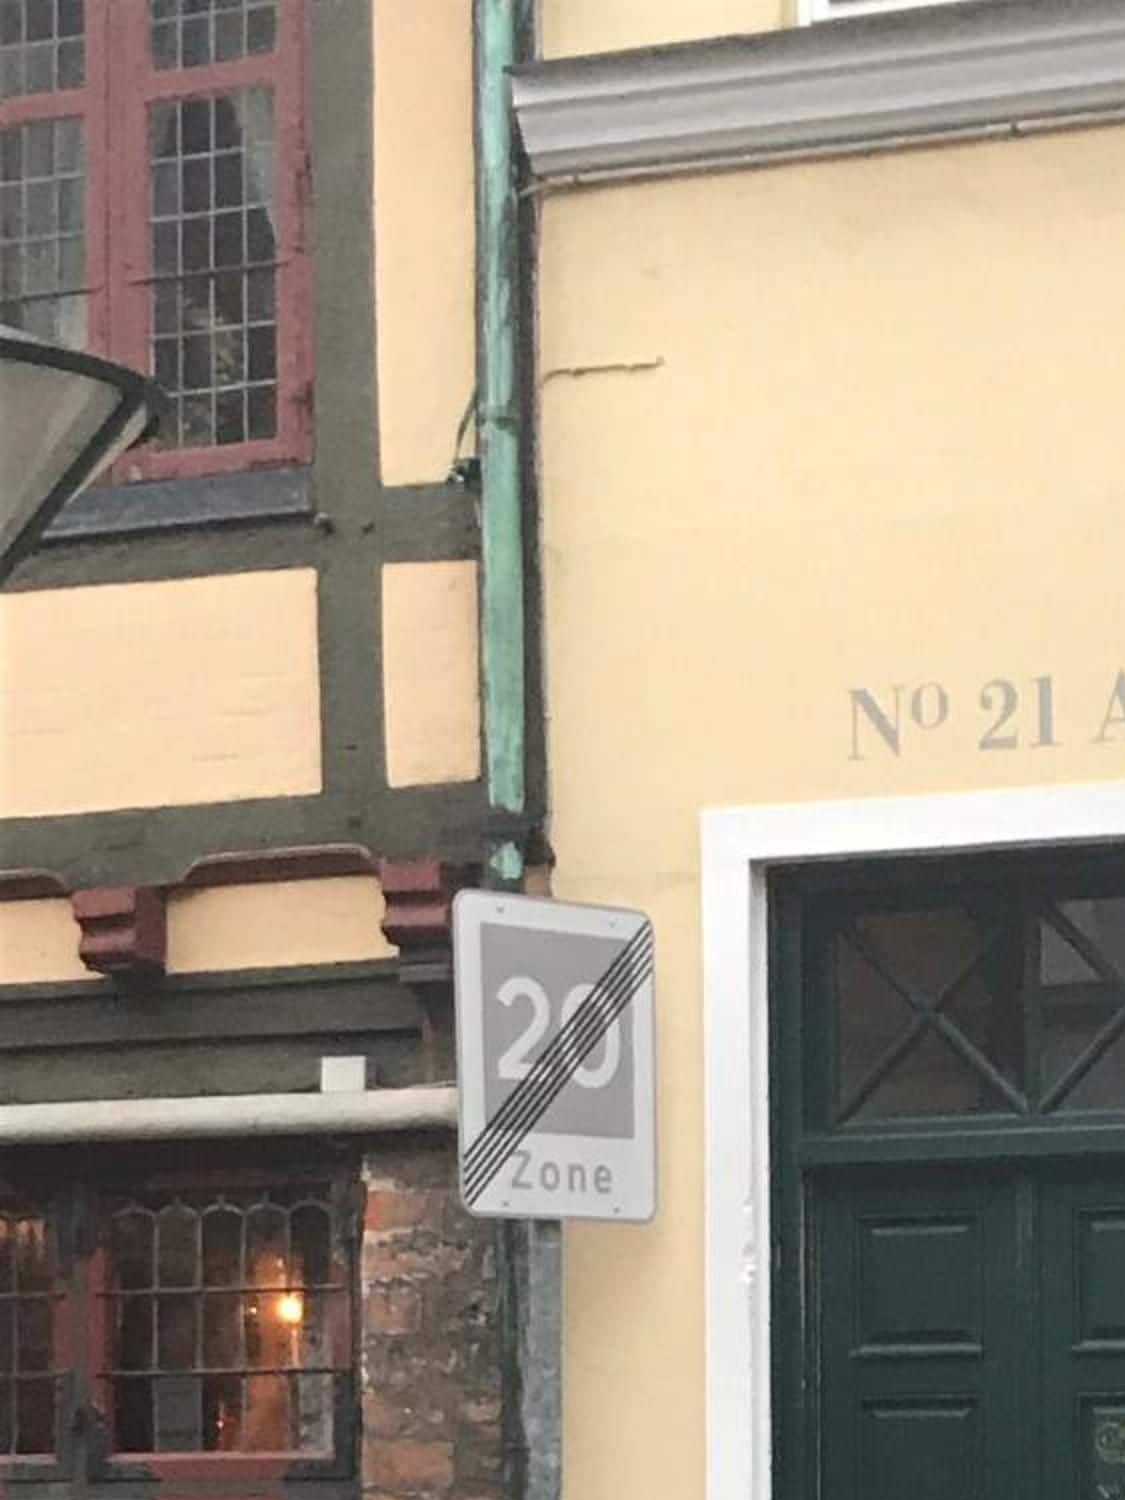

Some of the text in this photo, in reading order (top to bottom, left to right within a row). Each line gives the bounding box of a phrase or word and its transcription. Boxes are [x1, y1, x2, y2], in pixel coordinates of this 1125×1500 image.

[978, 673, 1063, 752] 21
[496, 975, 621, 1089] 20
[510, 1150, 614, 1194] Zone
